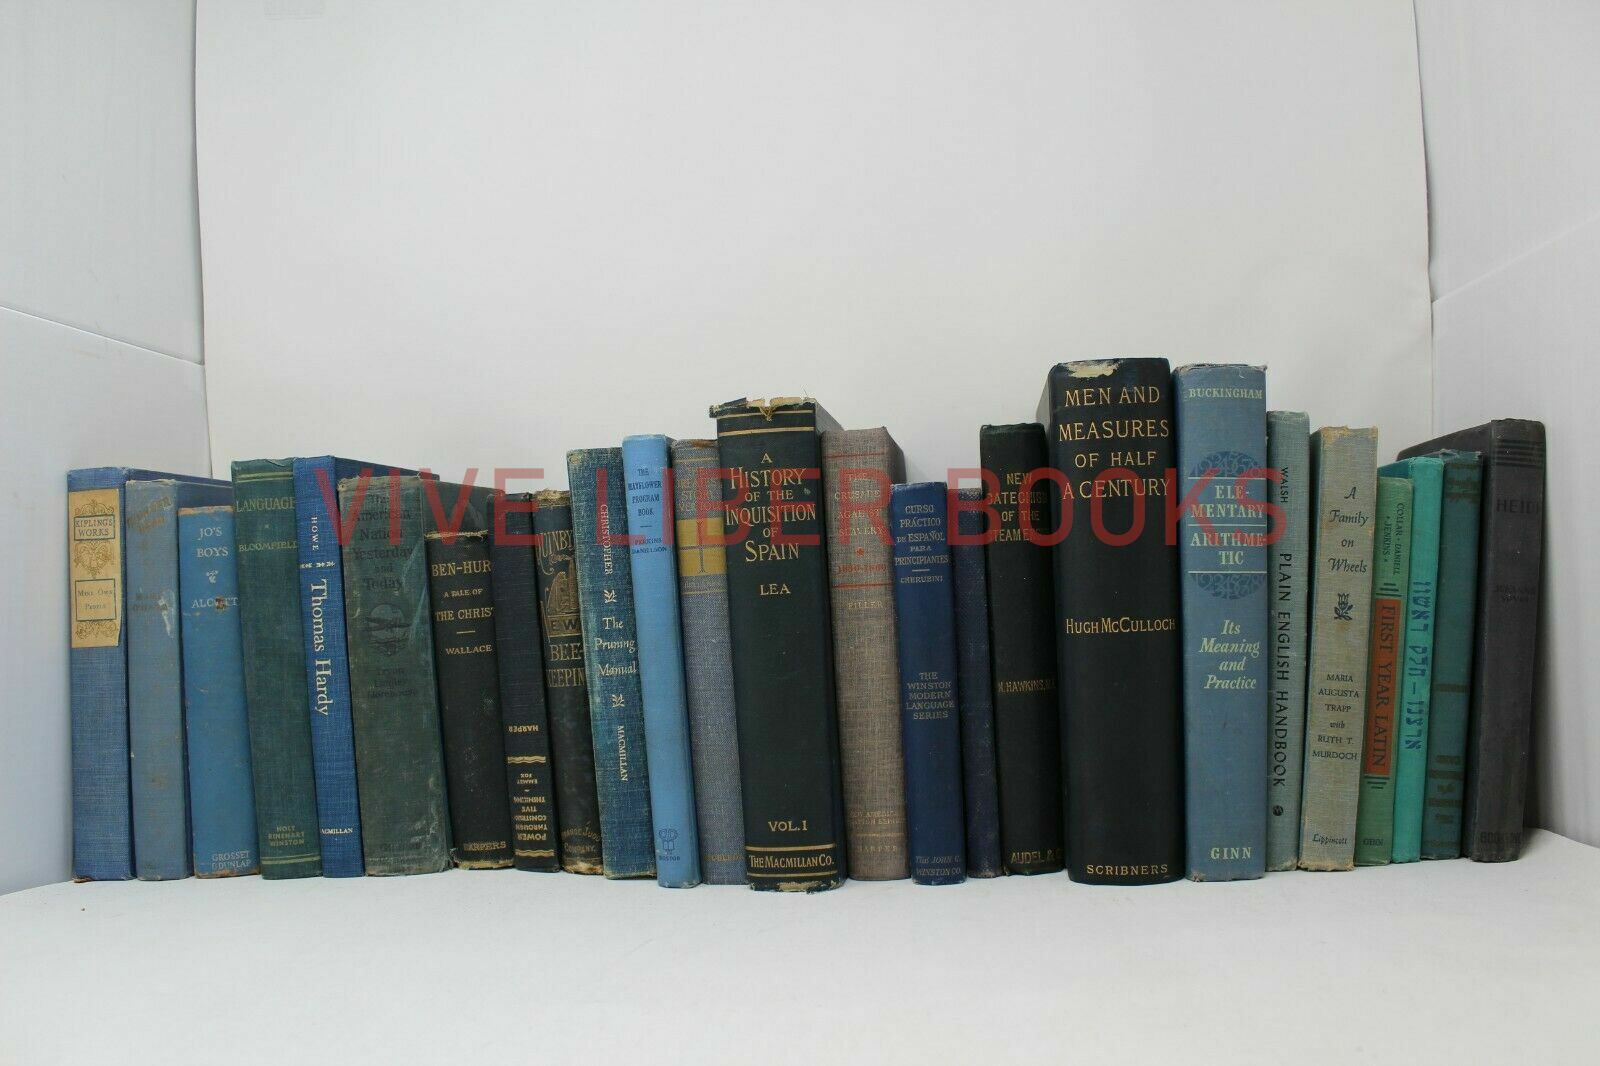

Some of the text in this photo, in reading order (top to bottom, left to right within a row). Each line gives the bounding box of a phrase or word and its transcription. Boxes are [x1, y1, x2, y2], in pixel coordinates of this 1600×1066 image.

[1065, 386, 1160, 407] MEN AND
[1188, 387, 1263, 399] BUCKINGHAM
[1059, 419, 1170, 441] MEASURES
[761, 453, 773, 463] A
[1074, 451, 1157, 468] OF HALF
[729, 467, 807, 489] HISTORY
[1006, 472, 1032, 485] NEW
[1280, 466, 1289, 503] WALSH
[745, 490, 794, 502] OF THE
[1062, 479, 1170, 500] A CENTURY
[1215, 485, 1250, 499] ELE-
[1344, 487, 1356, 499] A
[725, 504, 816, 526] INQUISITION
[905, 504, 935, 514] CURSO
[1001, 510, 1015, 521] OF
[1191, 504, 1265, 518] MENTARY
[1328, 510, 1369, 527] Family
[78, 528, 110, 537] WORKS
[198, 527, 223, 541] JO'S
[311, 516, 319, 551] HOWE
[763, 527, 778, 537] OF
[600, 504, 613, 575] CHRISTOPHER
[1190, 532, 1267, 547] ARITHME-
[1341, 539, 1354, 548] on
[196, 546, 229, 558] BOYS
[745, 540, 800, 562] SPAIN
[1218, 551, 1244, 565] TIC
[432, 560, 492, 576] BEN-HUR
[1327, 557, 1368, 574] Wheels
[760, 583, 791, 596] LEA
[435, 607, 494, 621] THE CHRIS
[602, 617, 624, 630] The
[1066, 618, 1099, 634] HUGH
[1221, 619, 1241, 635] Its
[311, 579, 333, 716] Thomas Hardy
[446, 645, 493, 654] WALLACE
[595, 637, 636, 654] Pruning
[1199, 638, 1261, 658] Meaning
[599, 664, 637, 676] Manual
[1219, 657, 1246, 671] and
[1273, 553, 1293, 787] PLAIN ENGLISH HANDBOOK
[918, 671, 938, 680] THE
[1204, 674, 1257, 690] Practice
[1326, 673, 1353, 682] MARIA
[906, 681, 951, 690] WINSTON
[1372, 605, 1396, 767] FIRST YEAR LATIN
[1318, 688, 1359, 698] AUGUSTA
[1325, 703, 1352, 713] TRAPP
[1318, 735, 1342, 744] RUTH
[617, 725, 628, 782] MACMILLAN
[1312, 750, 1357, 761] MURDOCH
[212, 850, 250, 861] GROSSET
[1011, 851, 1044, 864] AUDEL
[1210, 846, 1252, 860] GINN
[1087, 864, 1169, 877] SCRIBNERS
